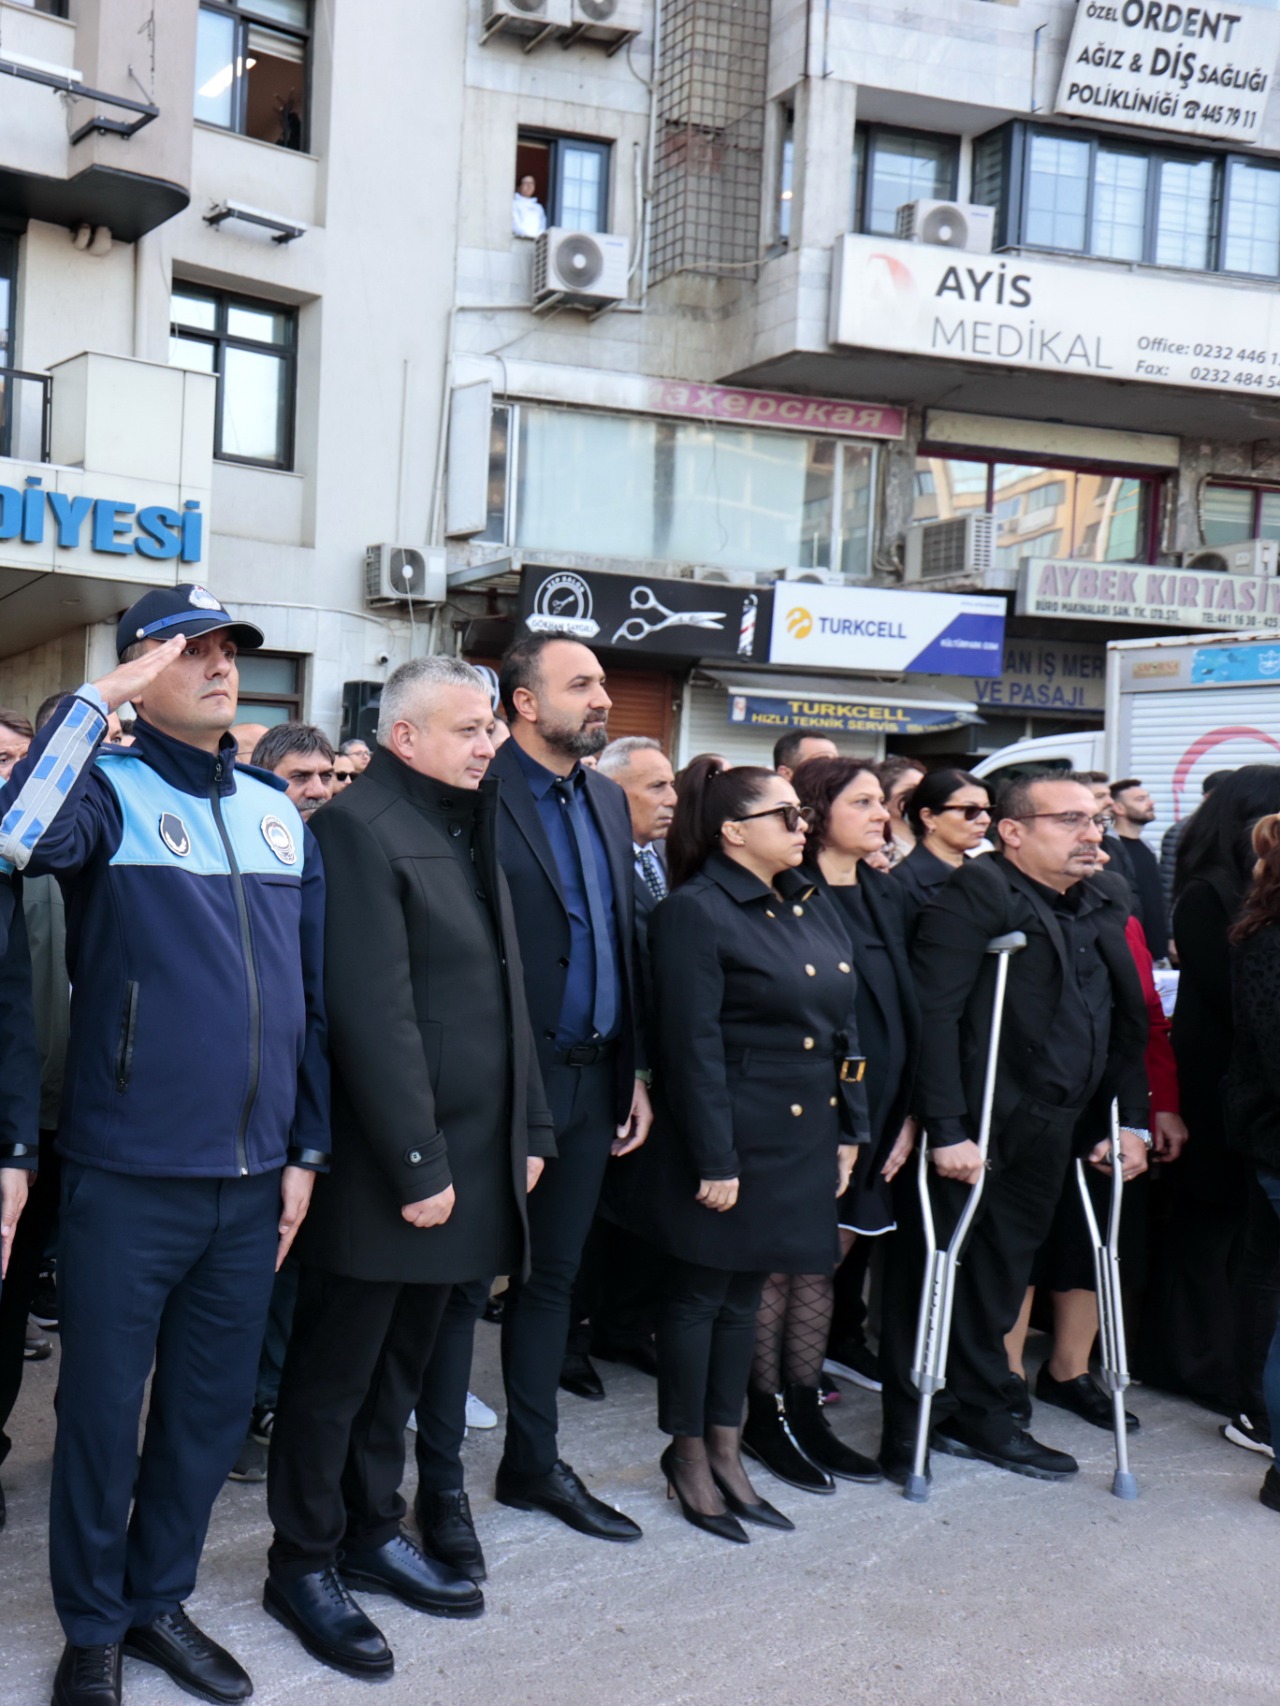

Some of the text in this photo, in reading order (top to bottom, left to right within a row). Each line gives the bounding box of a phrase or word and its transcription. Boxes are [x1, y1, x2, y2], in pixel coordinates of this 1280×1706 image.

[1086, 0, 1241, 43] ÖZEL ORDENT
[1076, 41, 1268, 93] AĞIZ & DİŞ SAĞLIĞI
[1067, 82, 1257, 129] POLİKLİNİĞİ 445 79 11
[935, 262, 1032, 308] AYİS
[931, 316, 1113, 370] MEDİKAL
[1137, 336, 1280, 367] Office: 0232 446 1
[1135, 360, 1170, 377] Fax:
[1190, 366, 1231, 384] 0232
[1233, 372, 1263, 387] 484
[1037, 564, 1138, 603] AYBEK
[819, 617, 907, 639] TURKCELL
[1038, 647, 1056, 682] İŞ
[975, 680, 1086, 706] VE PASAJI
[752, 713, 788, 726] HIZLI
[793, 715, 844, 729] TEKNİK
[847, 718, 899, 732] SERVİS
[788, 701, 911, 721] TURKCELL
